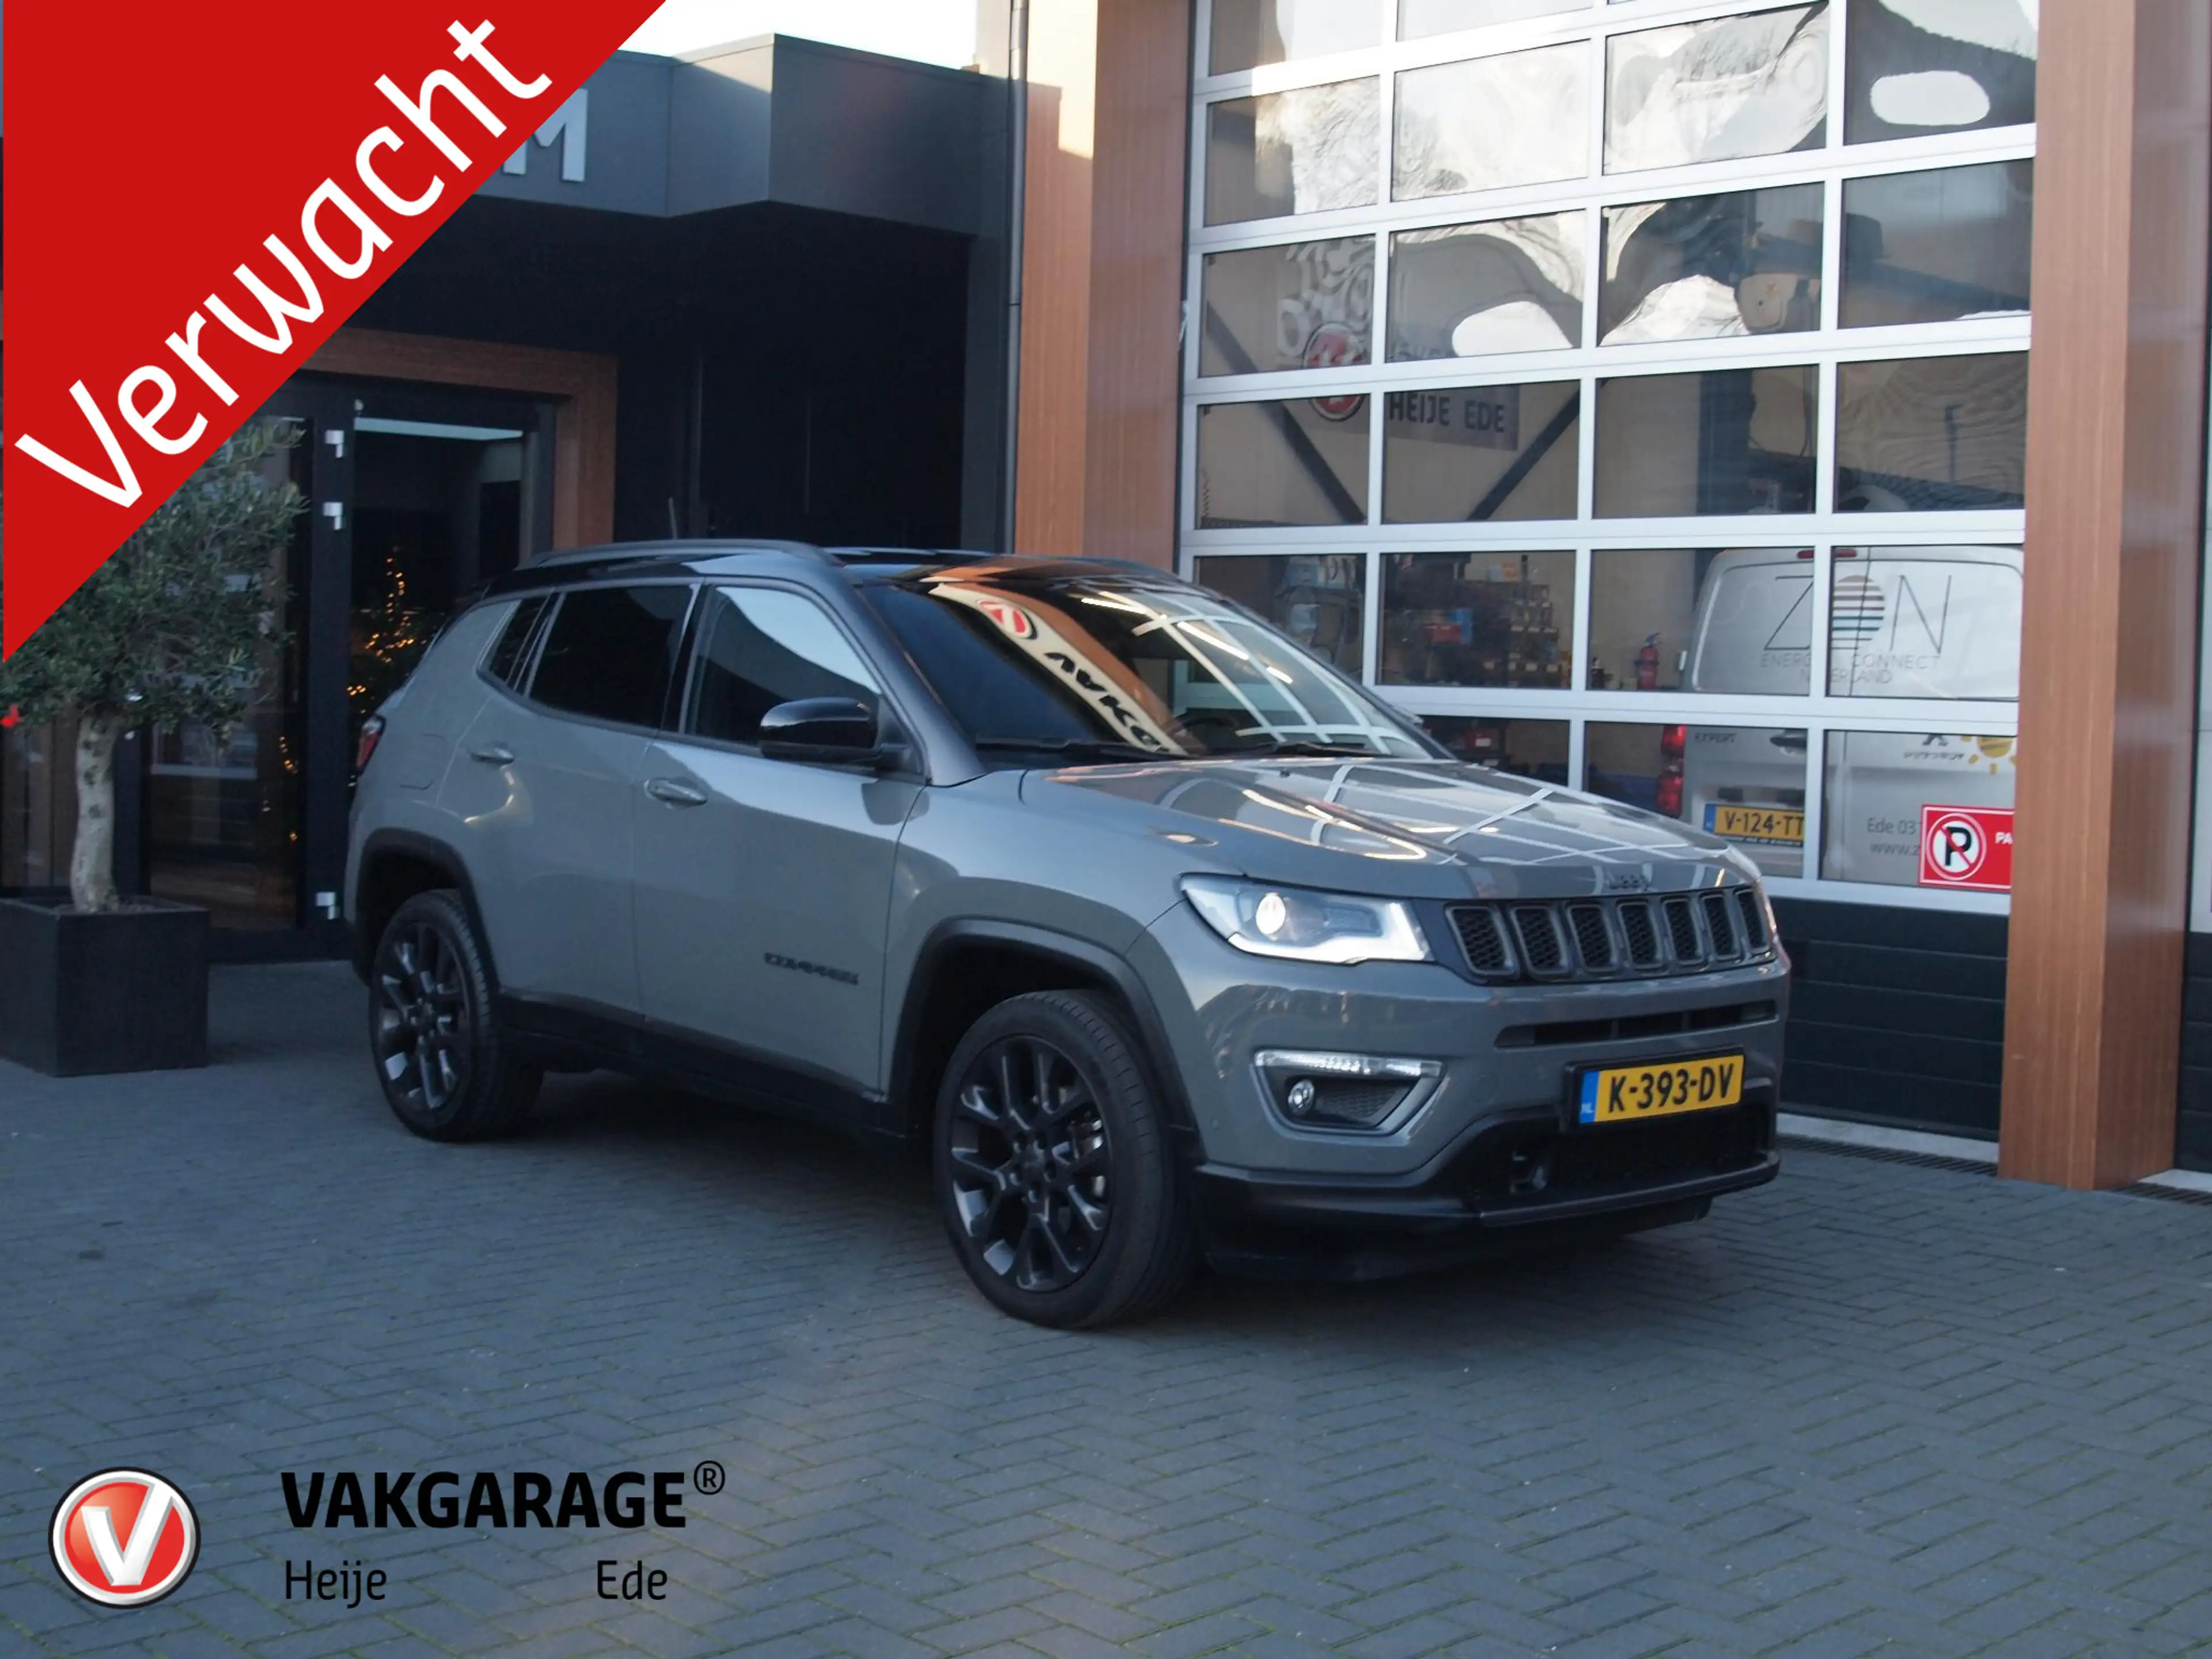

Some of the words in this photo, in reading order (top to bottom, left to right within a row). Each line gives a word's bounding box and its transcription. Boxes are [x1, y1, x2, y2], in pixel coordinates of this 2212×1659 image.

[1389, 392, 1450, 426] HEIJE
[1464, 400, 1505, 433] EDE
[1867, 817, 1893, 834] Ede
[1608, 1063, 1734, 1113] K-393-DV
